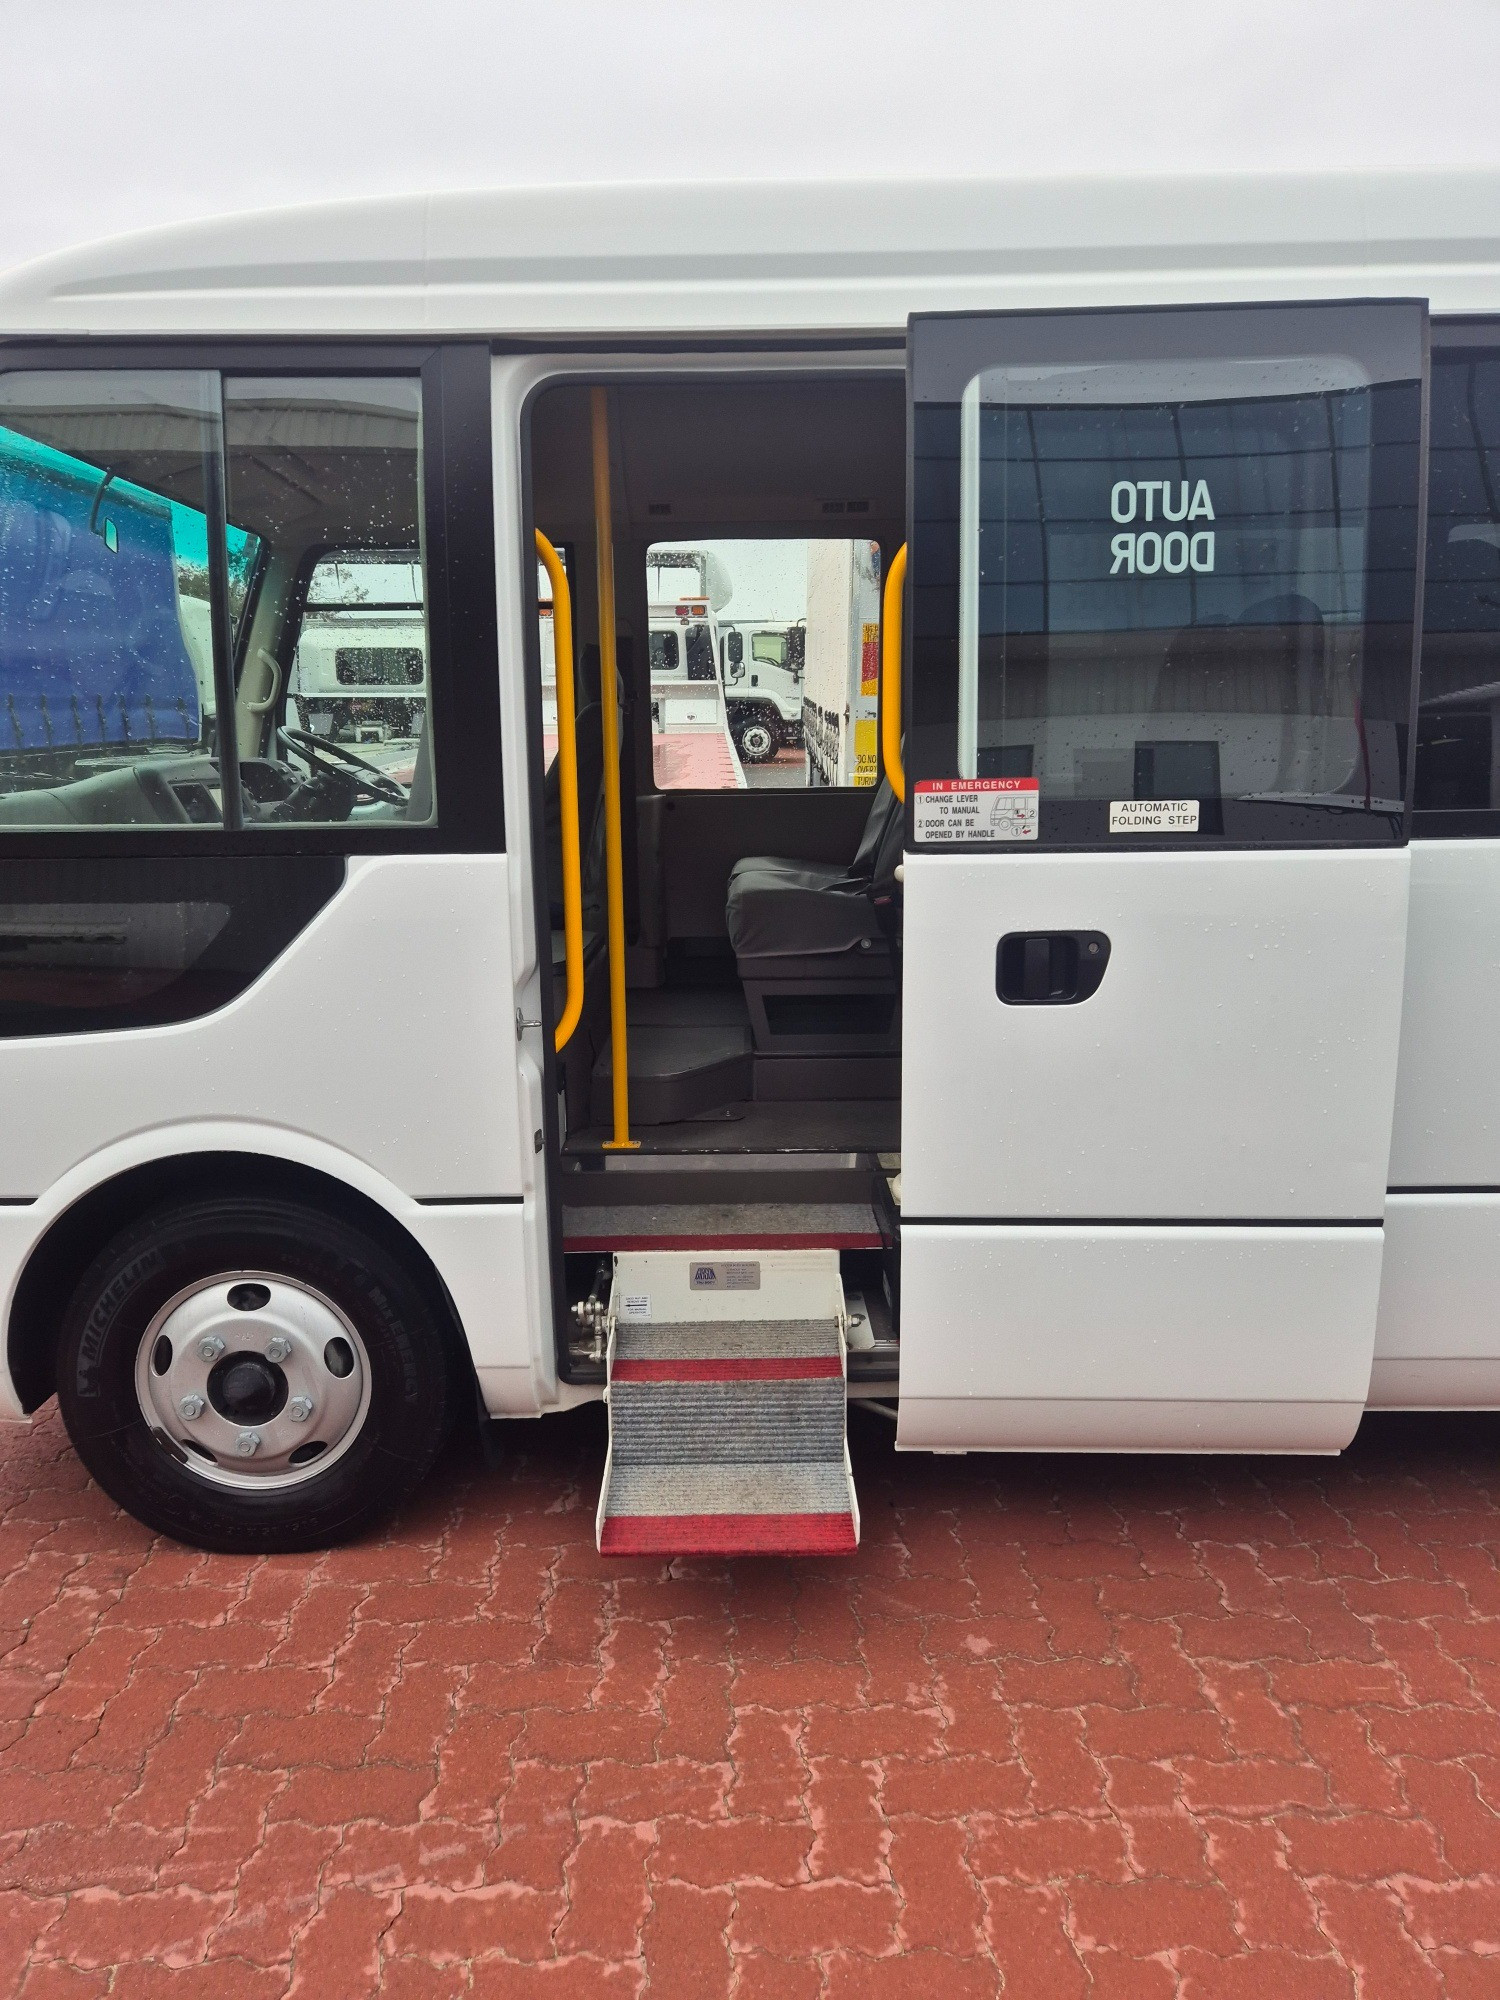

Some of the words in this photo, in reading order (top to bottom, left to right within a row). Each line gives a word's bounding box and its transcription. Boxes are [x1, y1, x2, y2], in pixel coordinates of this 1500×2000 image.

[932, 782, 943, 790] IN
[951, 780, 1021, 790] EMERGENCY
[925, 795, 953, 803] CHANGE
[956, 794, 978, 803] LEVER
[939, 806, 949, 815] TO
[952, 806, 980, 814] MANUAL
[1121, 802, 1188, 812] AUTOMATIC
[925, 819, 945, 827] DOOR
[947, 819, 962, 827] CAN
[965, 818, 975, 826] BE
[1112, 815, 1162, 825] FOLDING
[1168, 815, 1197, 824] STEP
[925, 830, 953, 838] OPENED
[955, 830, 965, 838] BY
[968, 829, 995, 837] HANDLE
[80, 1250, 161, 1361] MICHELIN
